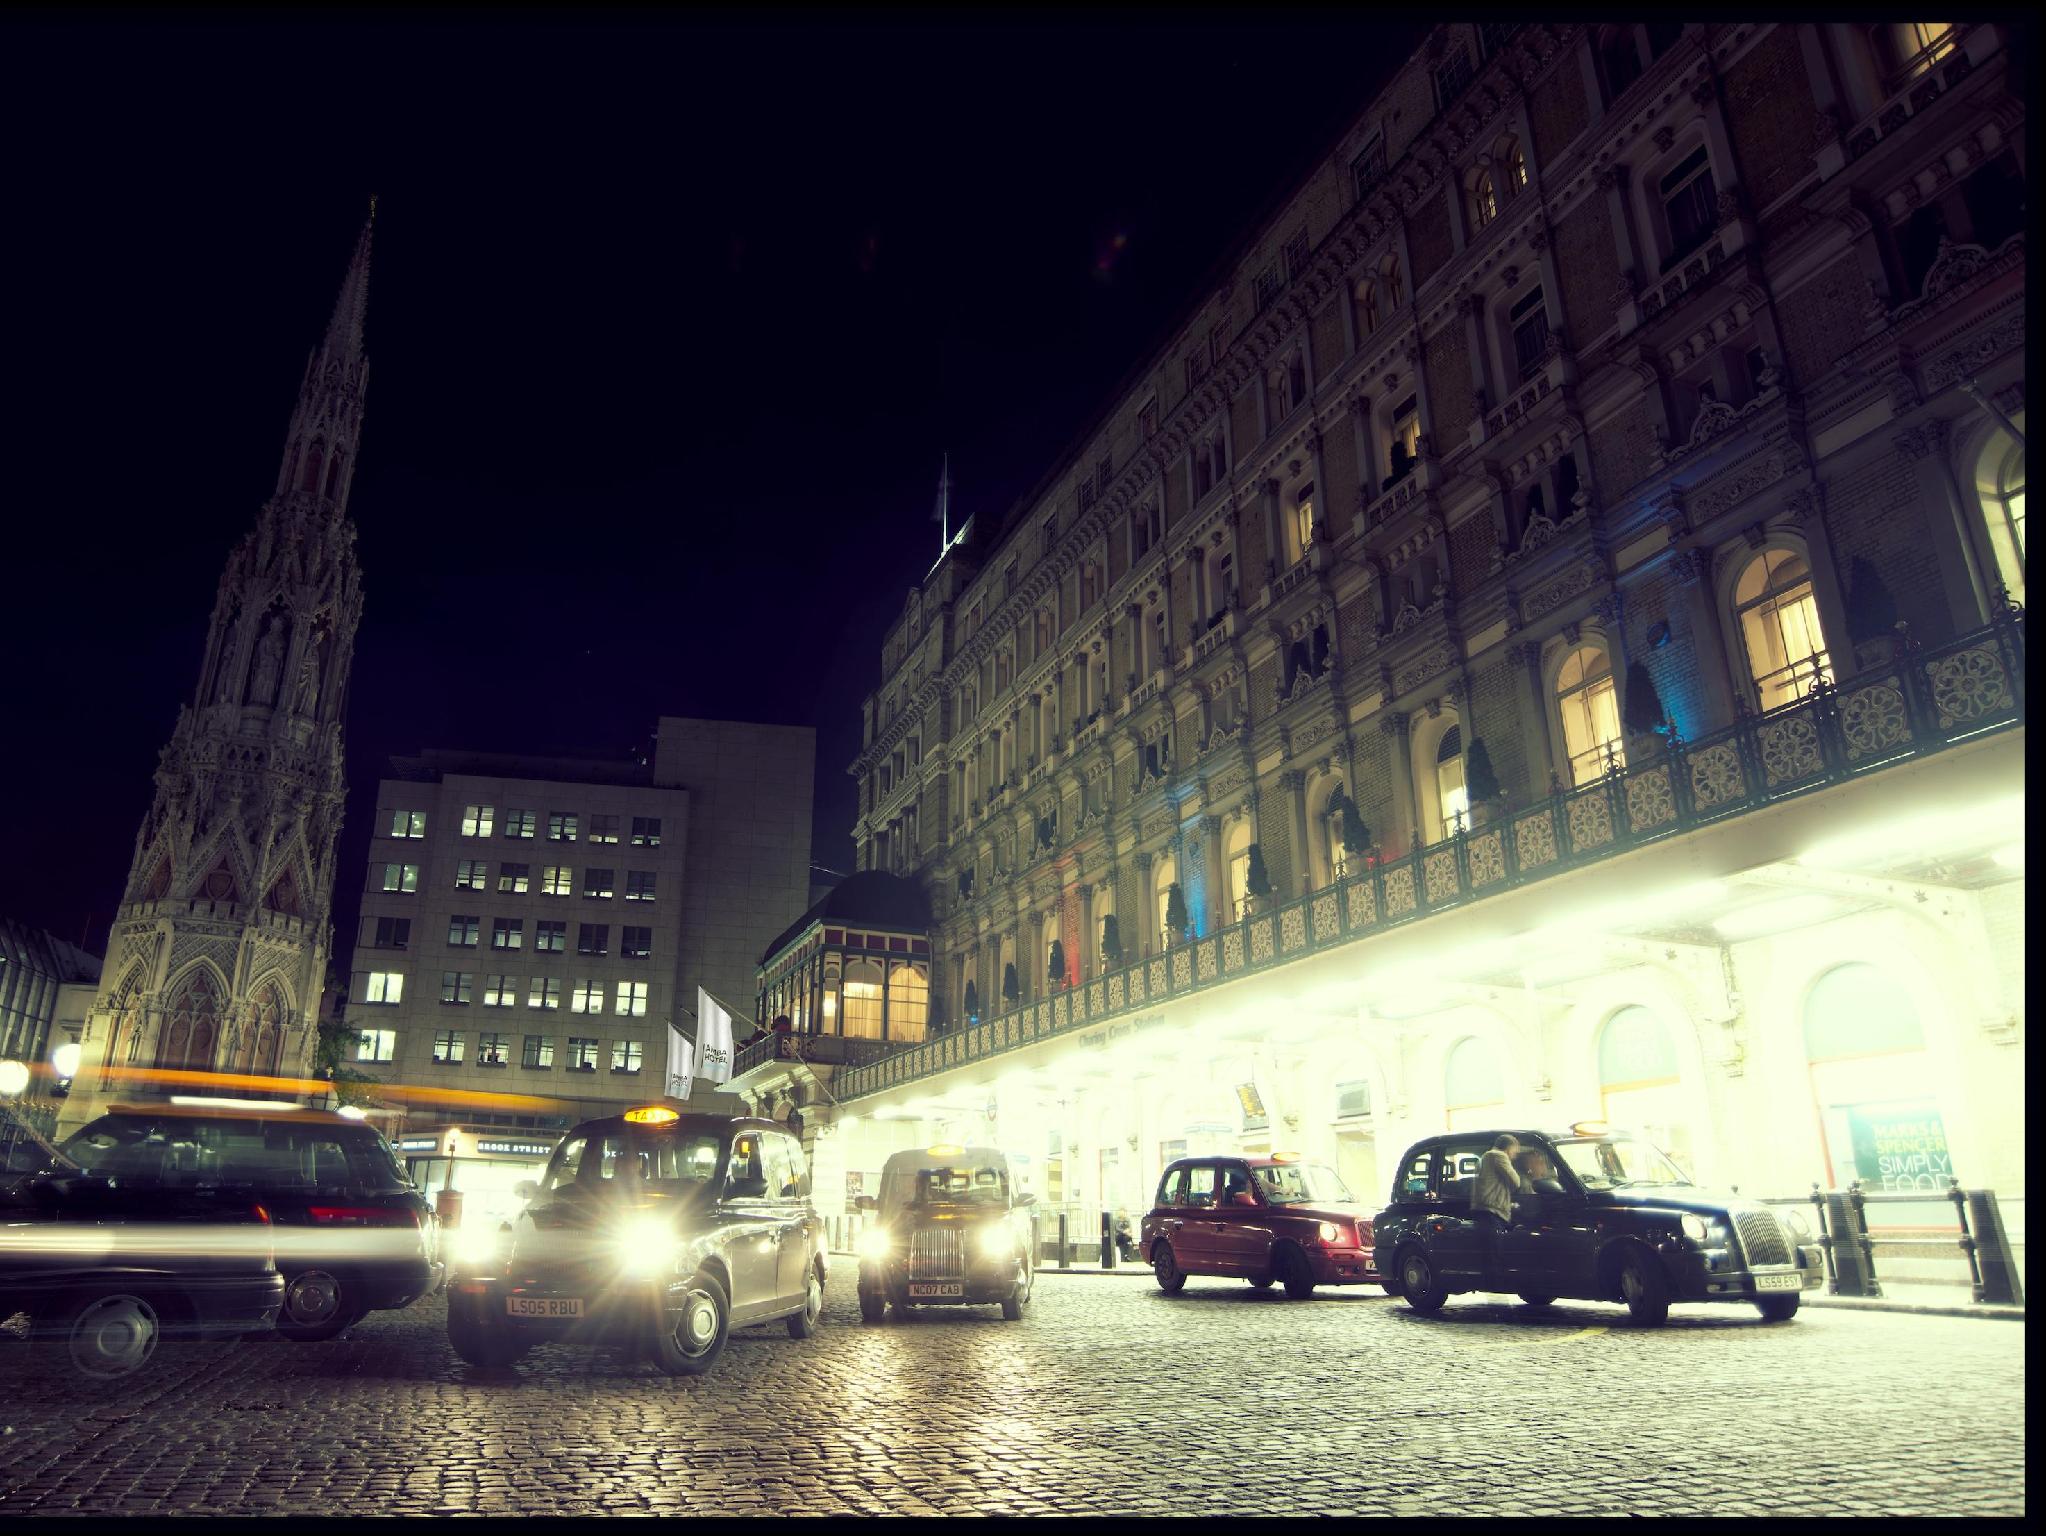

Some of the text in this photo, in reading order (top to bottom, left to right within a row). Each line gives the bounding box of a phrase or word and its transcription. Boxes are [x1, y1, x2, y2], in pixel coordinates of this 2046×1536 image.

[1109, 1025, 1131, 1040] Cross
[705, 1044, 727, 1056] AMBA
[704, 1053, 728, 1064] HOTEL
[478, 1143, 551, 1154] BROOK STREET
[1876, 1136, 1947, 1154] SPENCER
[1878, 1153, 1948, 1174] SIMPLY
[913, 1285, 960, 1295] NC07 CAB
[511, 1299, 577, 1315] LS05 RBU
